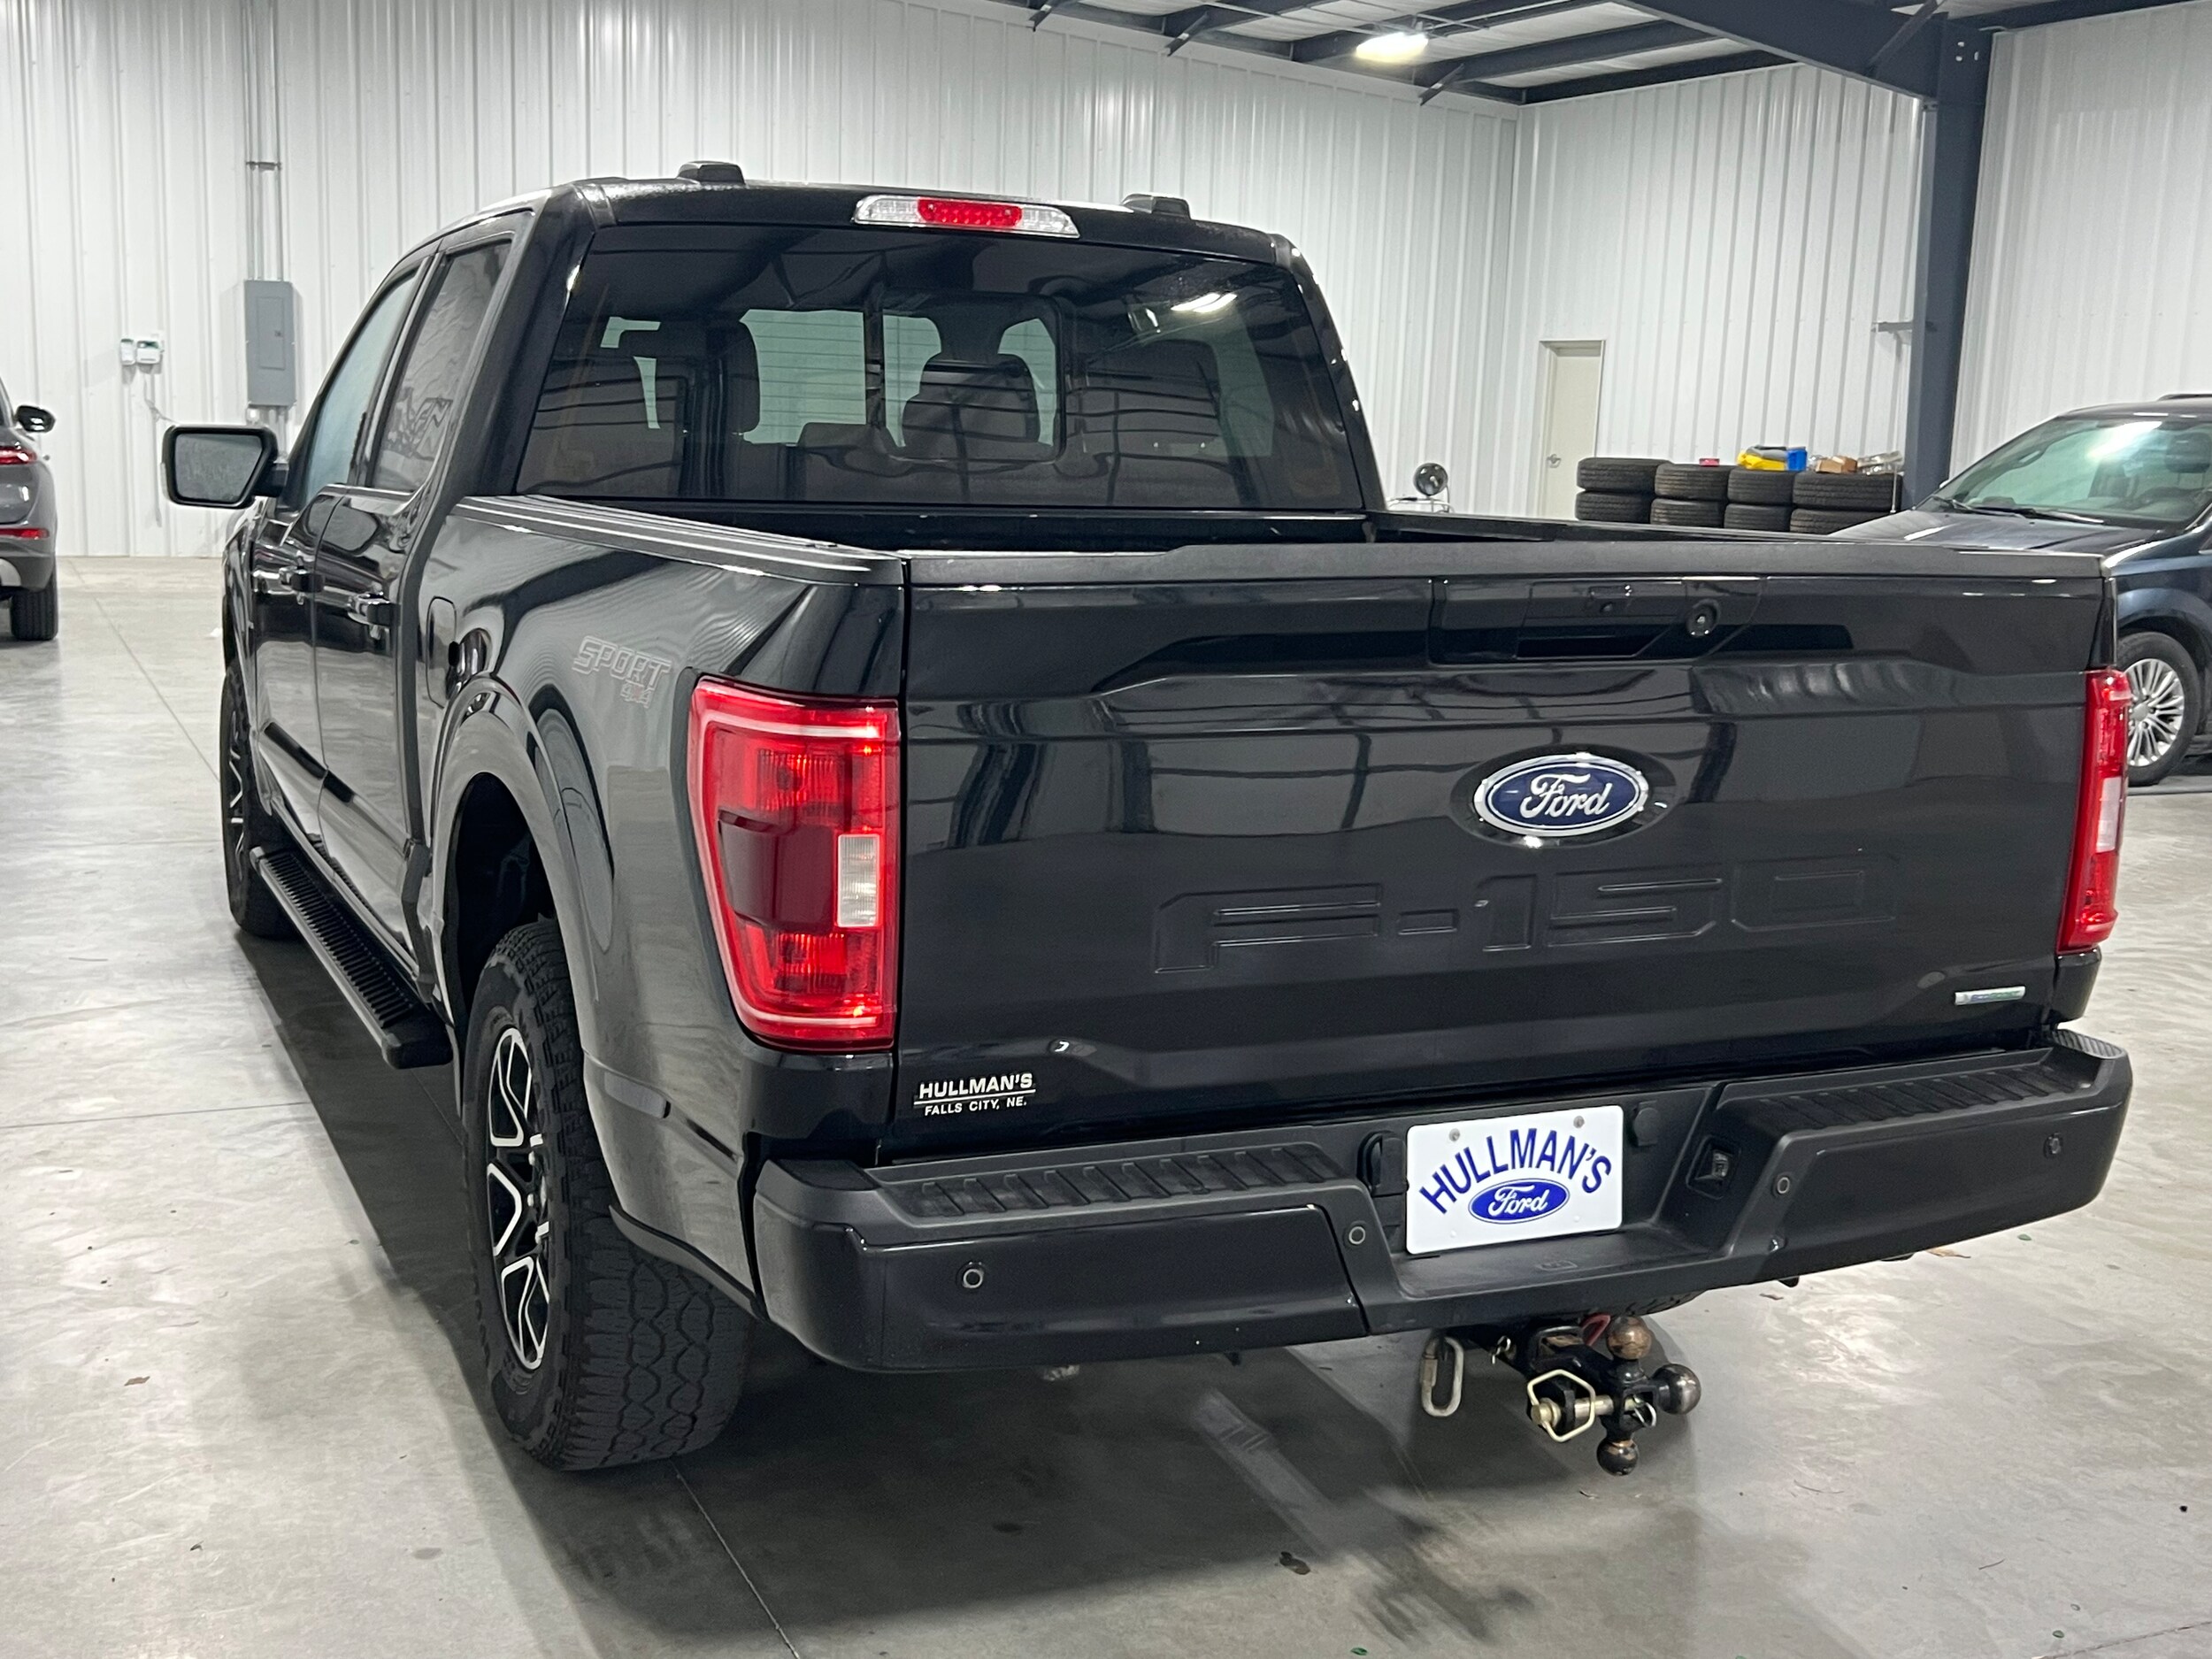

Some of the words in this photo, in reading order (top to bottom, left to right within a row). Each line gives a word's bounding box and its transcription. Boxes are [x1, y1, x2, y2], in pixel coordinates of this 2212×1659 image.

[572, 635, 672, 690] SPORT
[1519, 773, 1613, 818] Ford
[1154, 853, 1900, 974] F-150
[918, 1072, 1033, 1099] HULLMAN'S
[925, 1102, 963, 1116] FALLS
[969, 1098, 1000, 1110] CITY,
[1006, 1095, 1027, 1107] NE.
[1418, 1127, 1612, 1215] HULLMAN'S
[1487, 1184, 1550, 1217] Ford
